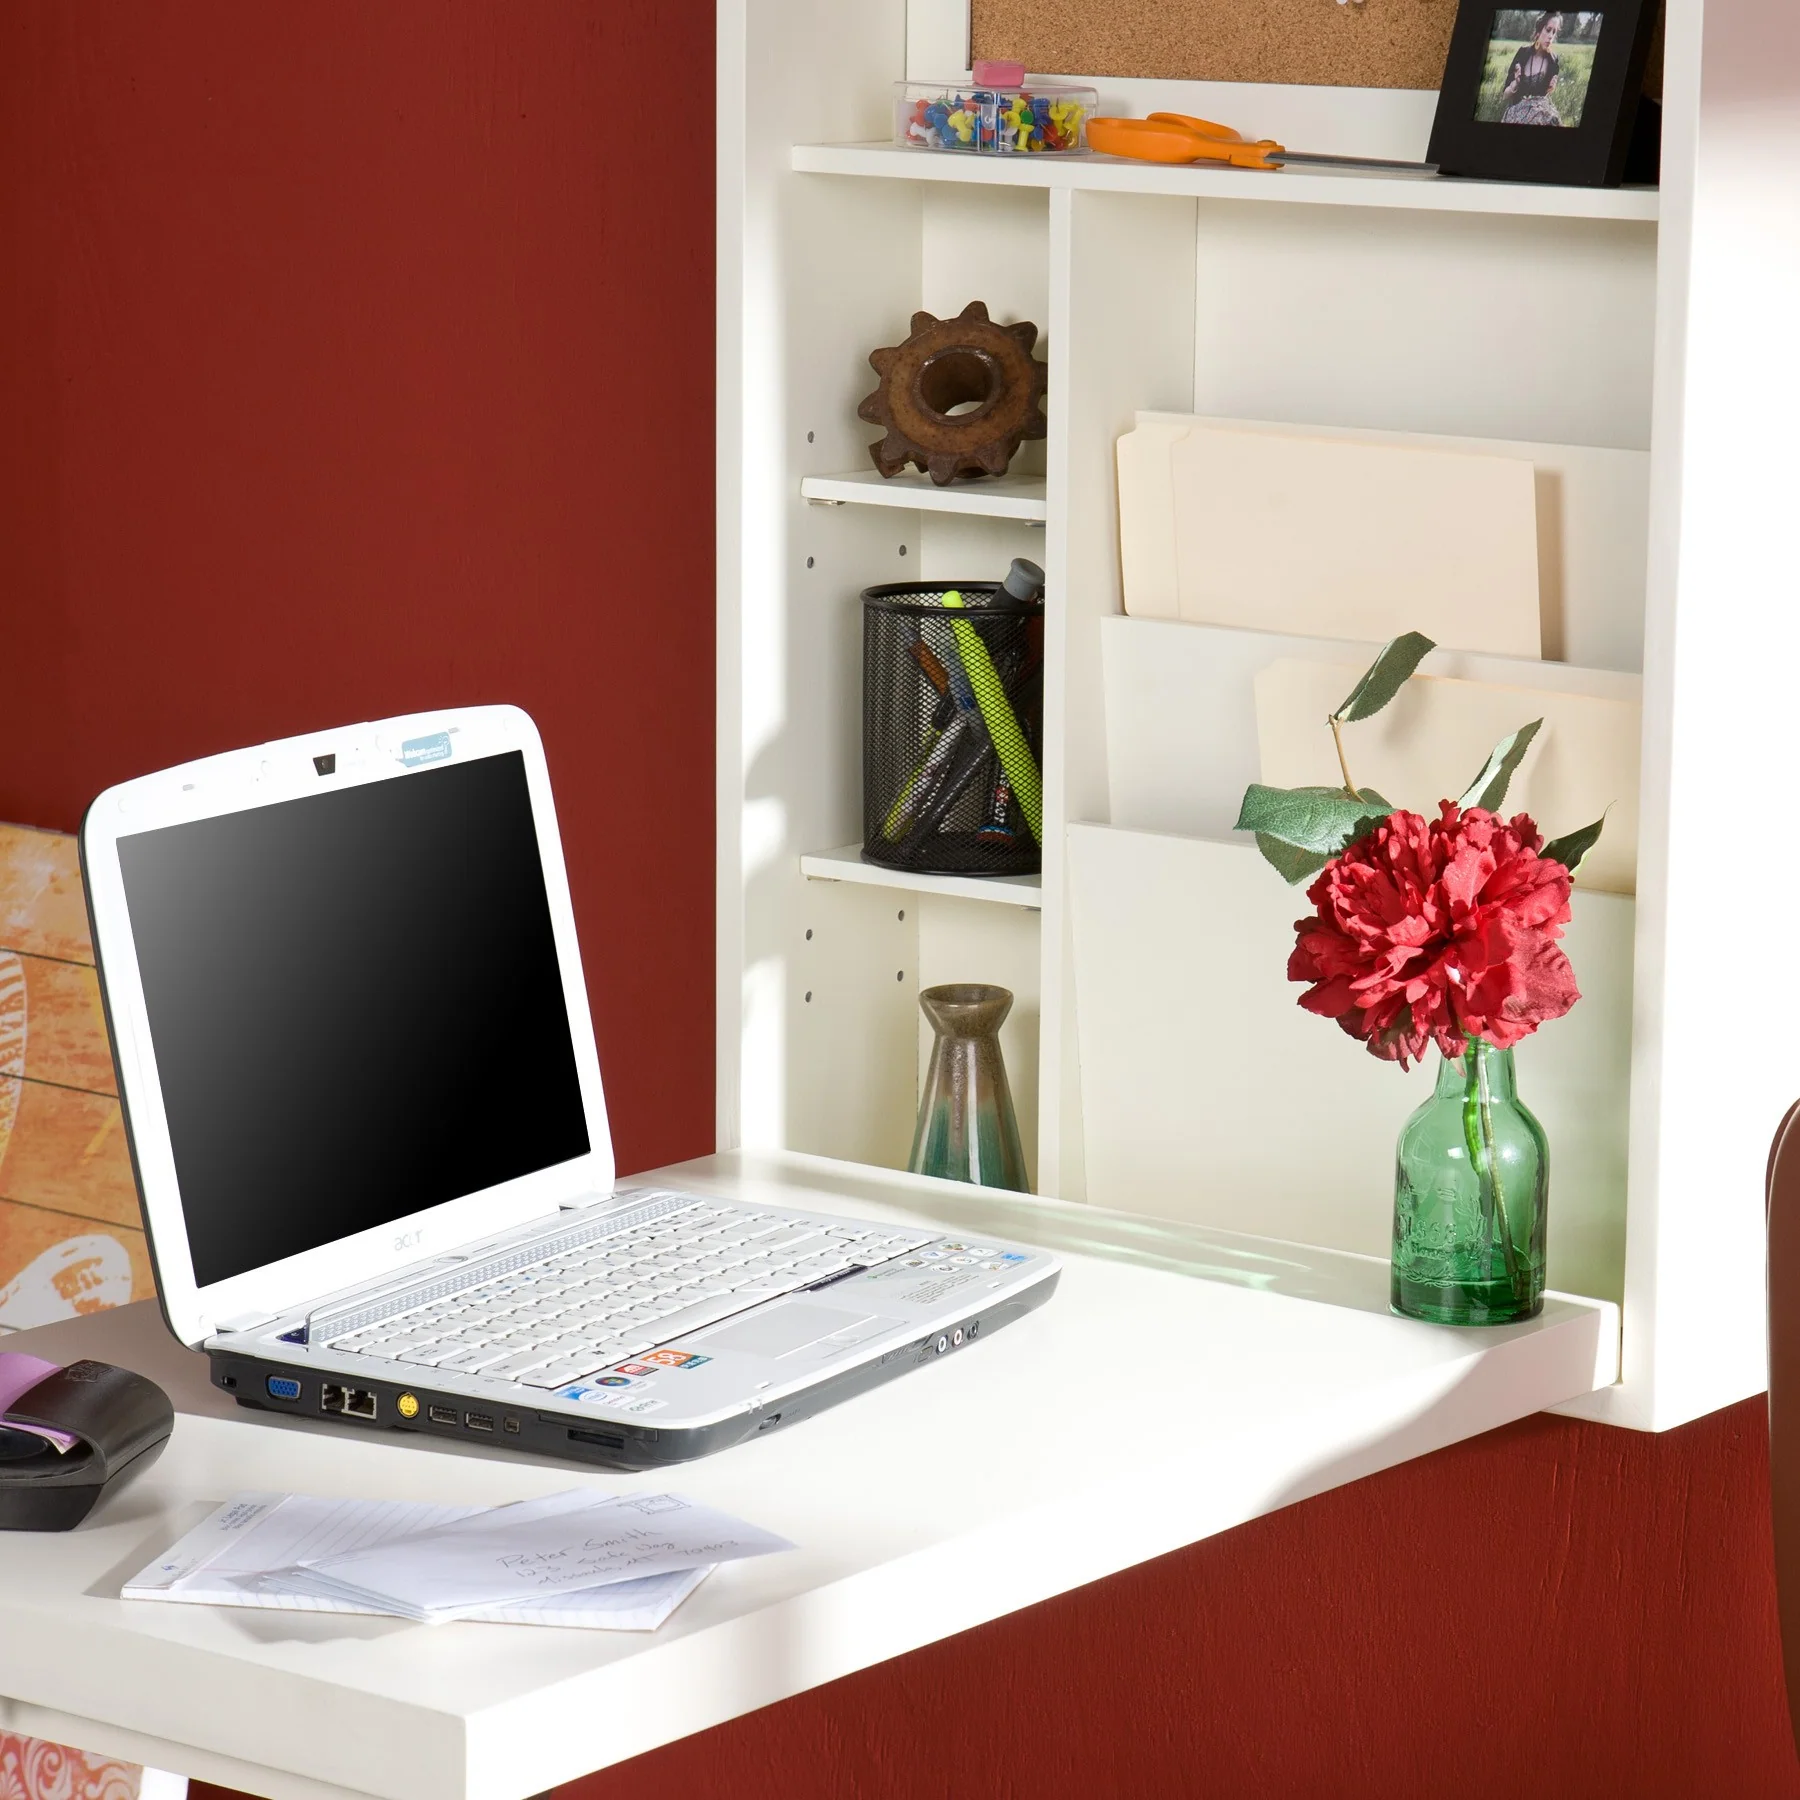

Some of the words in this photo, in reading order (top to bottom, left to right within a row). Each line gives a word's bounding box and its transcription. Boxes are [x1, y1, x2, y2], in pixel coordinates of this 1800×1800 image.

[646, 1352, 687, 1366] 58
[495, 1546, 575, 1569] Peter
[582, 1527, 664, 1552] Smith
